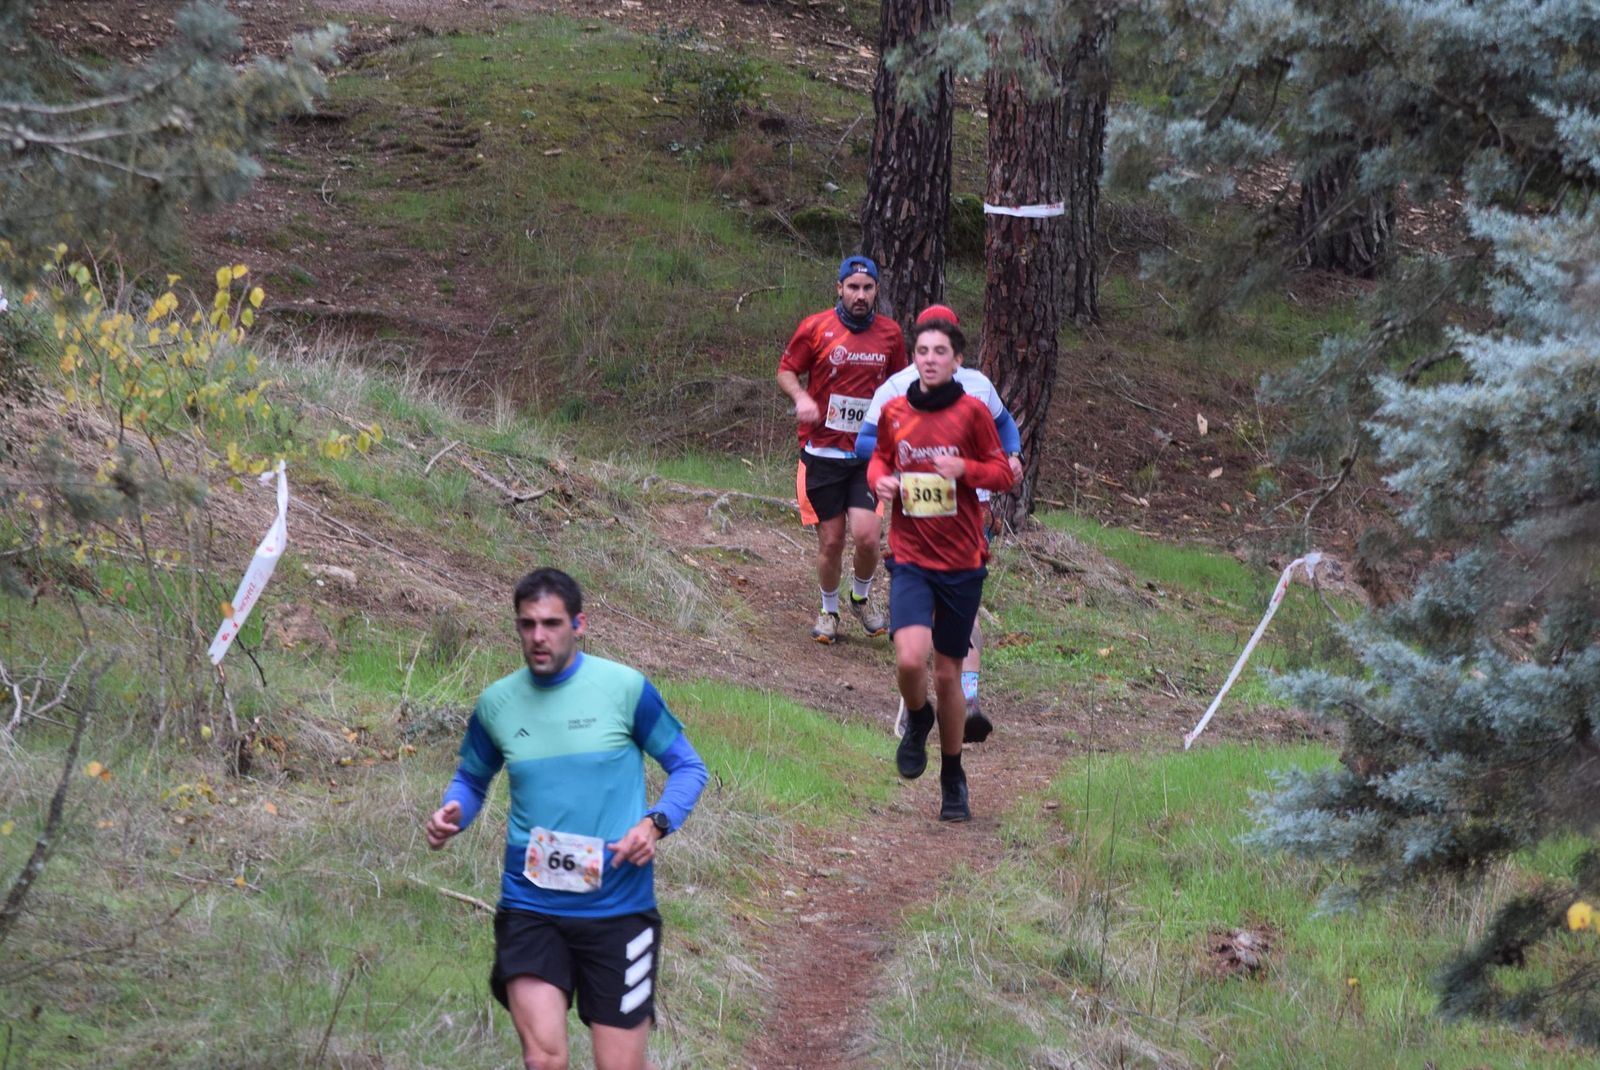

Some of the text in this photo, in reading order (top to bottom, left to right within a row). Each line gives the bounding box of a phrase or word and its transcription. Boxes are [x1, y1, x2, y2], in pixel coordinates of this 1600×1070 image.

[840, 408, 864, 421] 190
[912, 487, 942, 502] 303
[548, 850, 576, 871] 66
